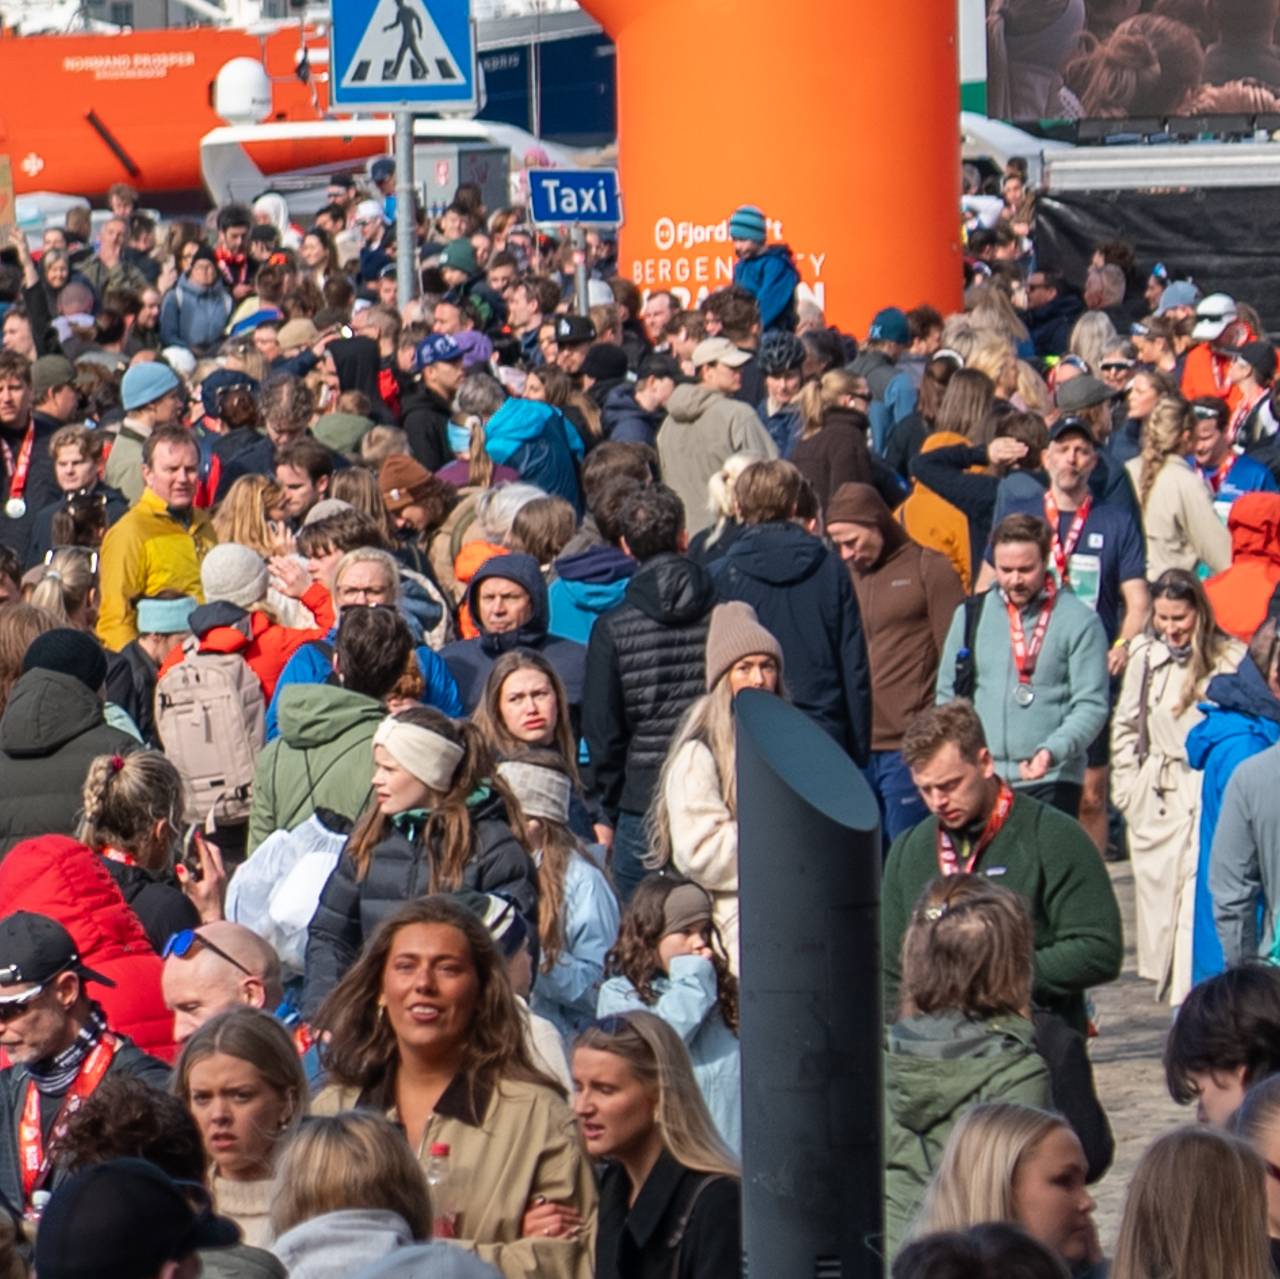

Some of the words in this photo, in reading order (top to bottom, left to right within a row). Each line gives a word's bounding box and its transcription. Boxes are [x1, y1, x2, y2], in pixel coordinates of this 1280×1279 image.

[541, 179, 607, 214] Taxi
[677, 218, 784, 249] Fjordt
[632, 256, 733, 285] BERGEN
